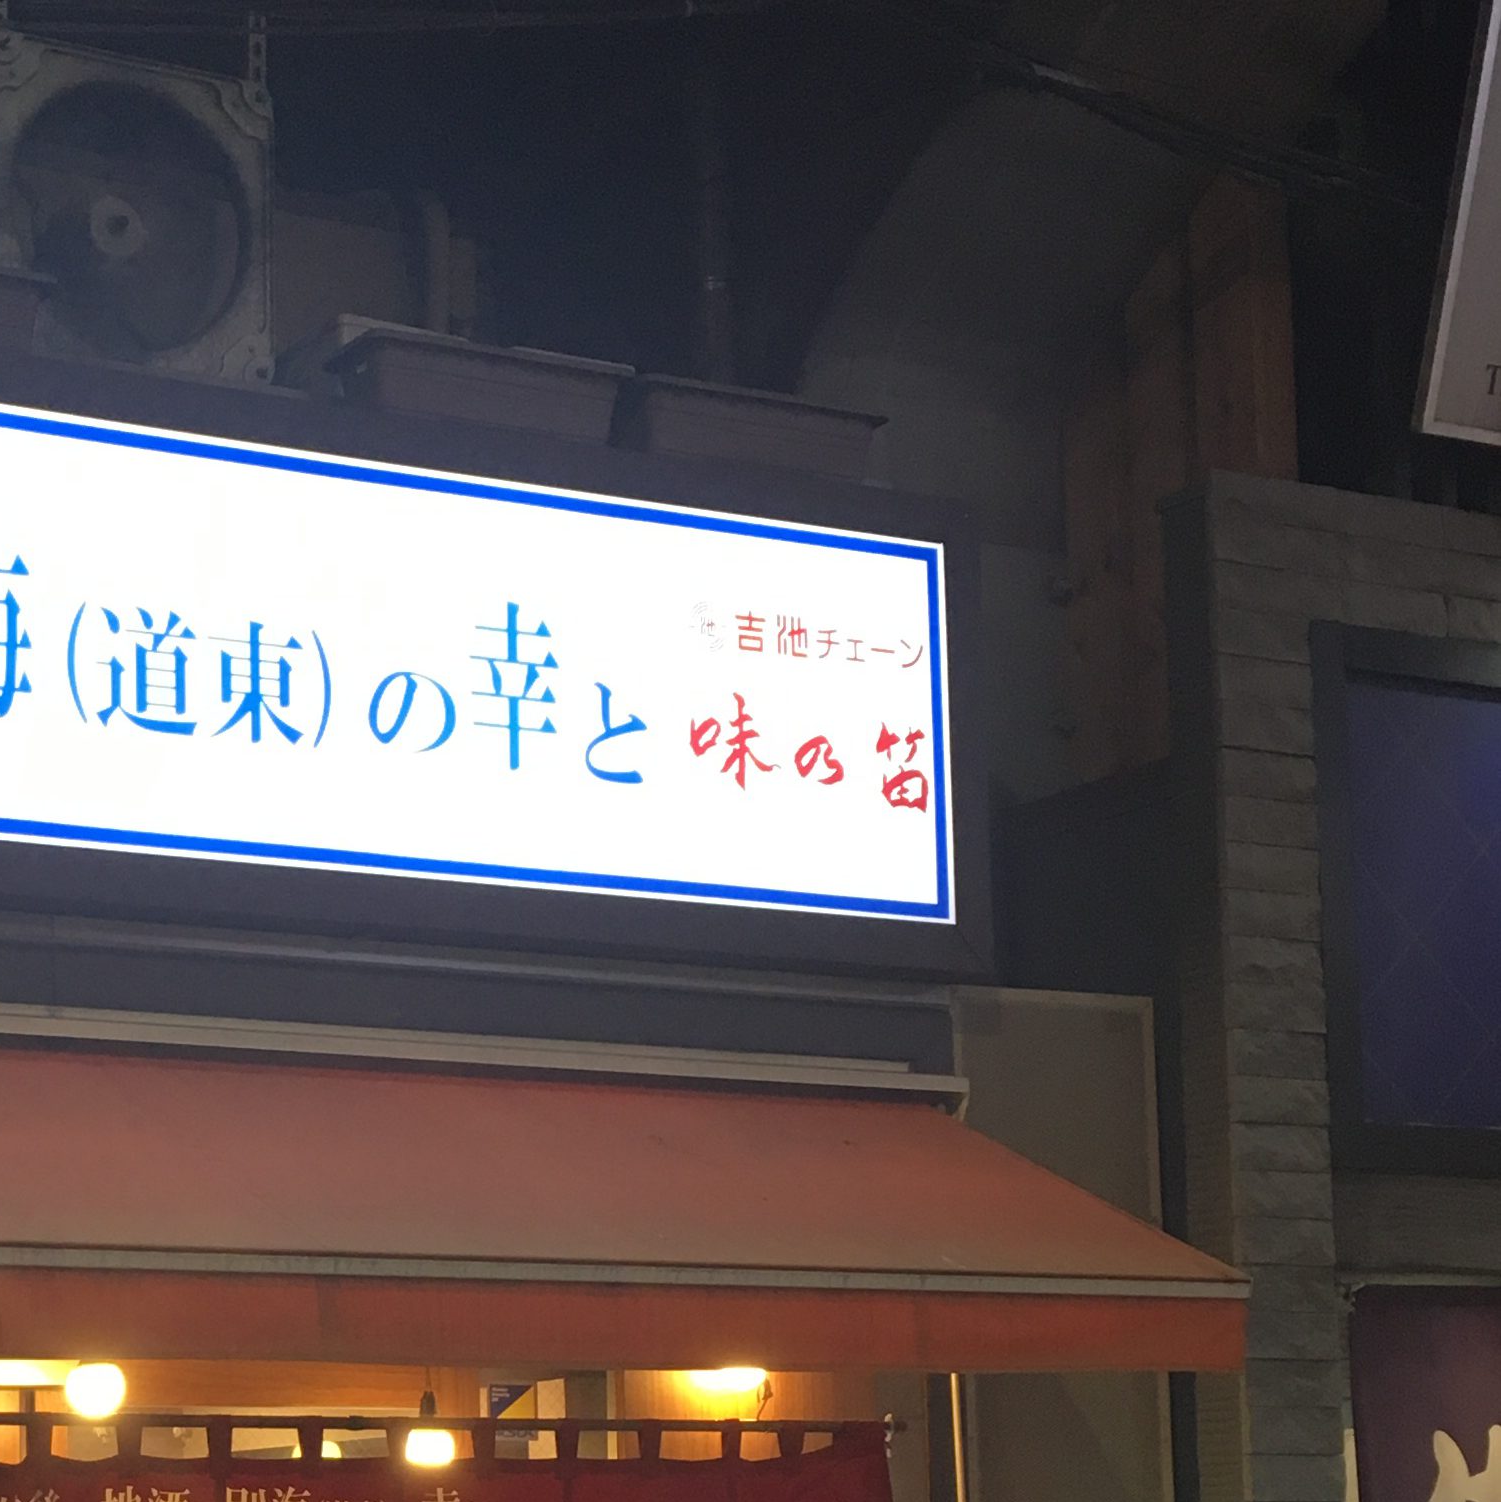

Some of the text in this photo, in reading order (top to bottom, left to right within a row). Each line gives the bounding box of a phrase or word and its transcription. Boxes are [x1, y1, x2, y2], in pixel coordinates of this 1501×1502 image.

[735, 611, 923, 668] 吉池チェーン
